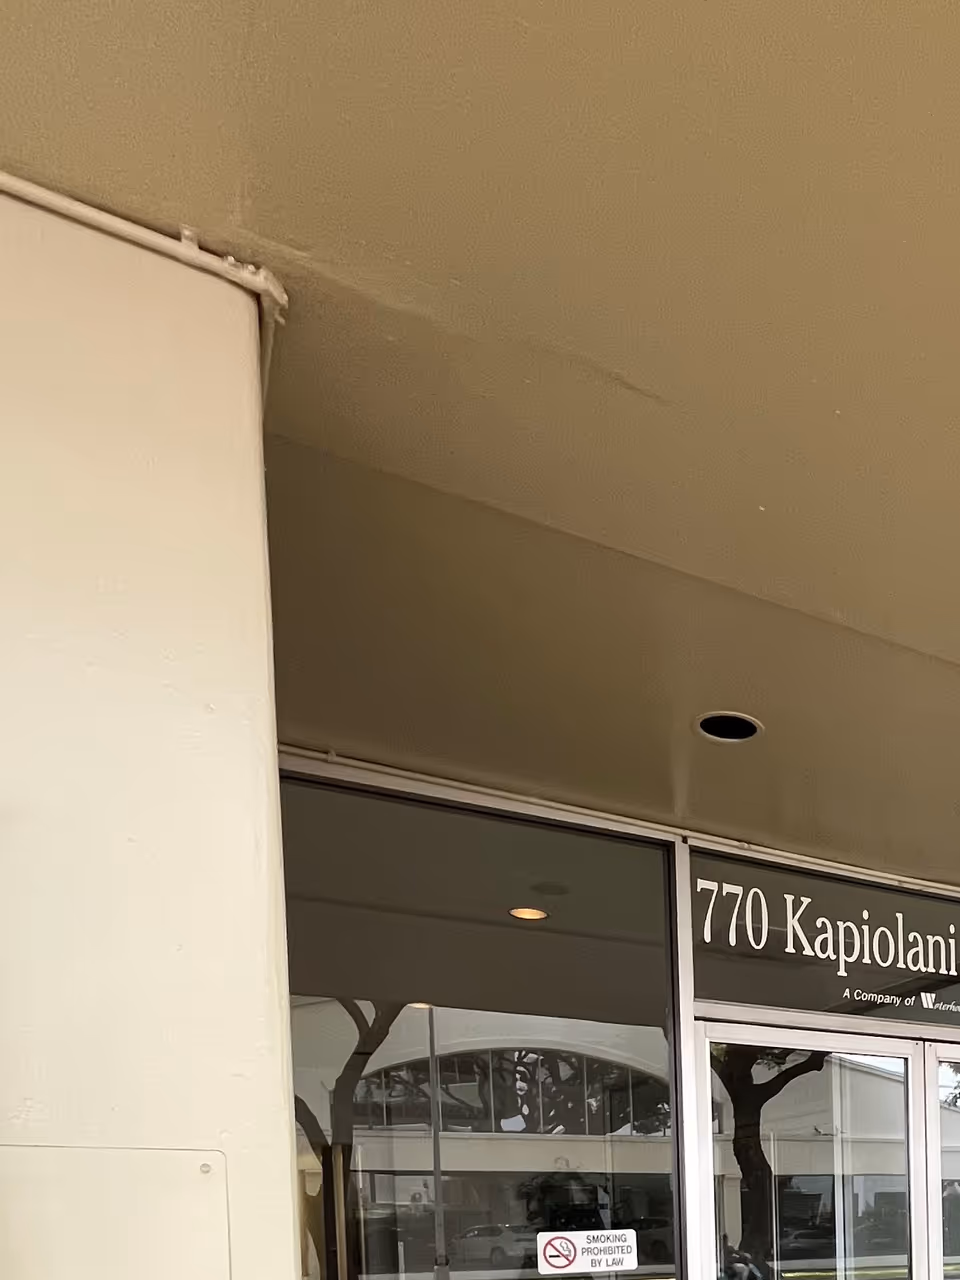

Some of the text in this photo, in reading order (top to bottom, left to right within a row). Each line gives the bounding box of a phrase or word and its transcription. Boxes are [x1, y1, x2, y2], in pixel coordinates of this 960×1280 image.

[696, 878, 769, 950] 770
[783, 893, 958, 977] Kapiolani
[843, 988, 851, 998] A
[853, 989, 902, 1007] Company
[904, 995, 915, 1006] of
[586, 1233, 627, 1244] SMOKING
[581, 1245, 632, 1256] PROHIBITED
[590, 1257, 624, 1267] BY LAW
